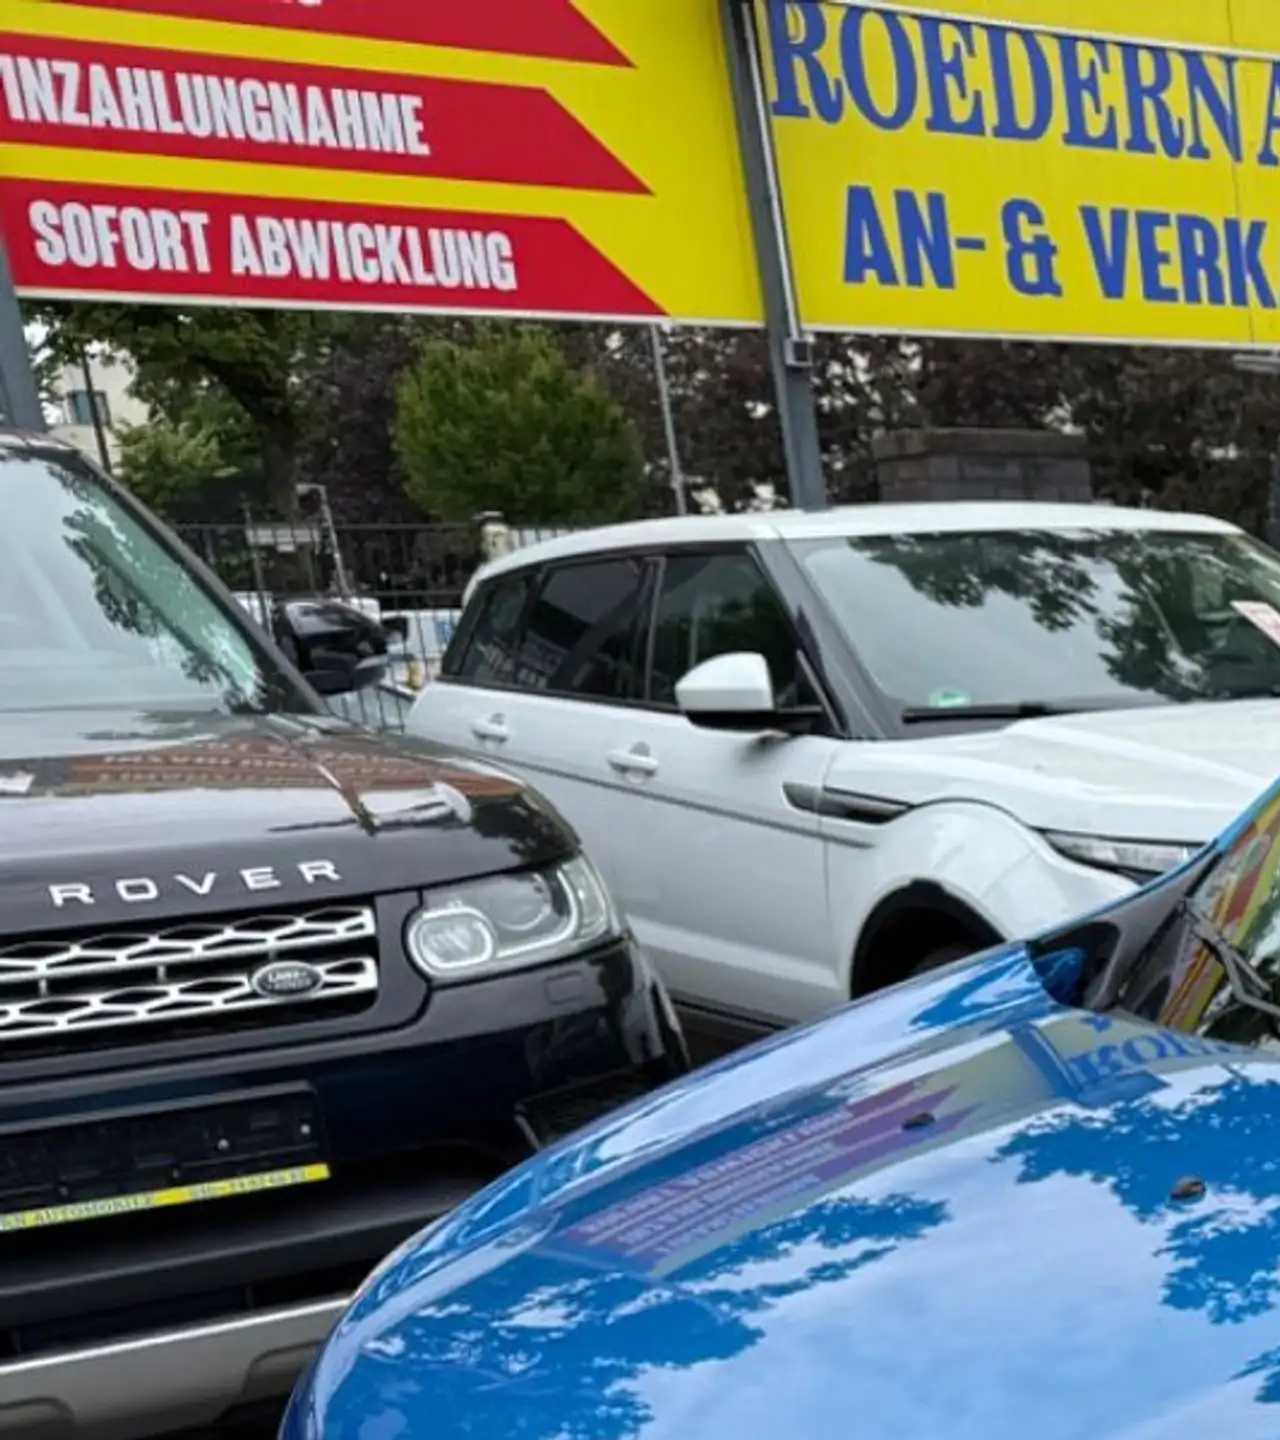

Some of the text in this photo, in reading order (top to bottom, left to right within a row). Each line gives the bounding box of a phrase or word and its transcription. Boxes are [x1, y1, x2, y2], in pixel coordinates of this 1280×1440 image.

[768, 1, 1244, 162] ROEDERN
[28, 200, 519, 291] SOFORT ABWICKLUNG
[842, 185, 987, 290] AN-
[1000, 199, 1063, 297] &
[48, 859, 344, 907] ROVER
